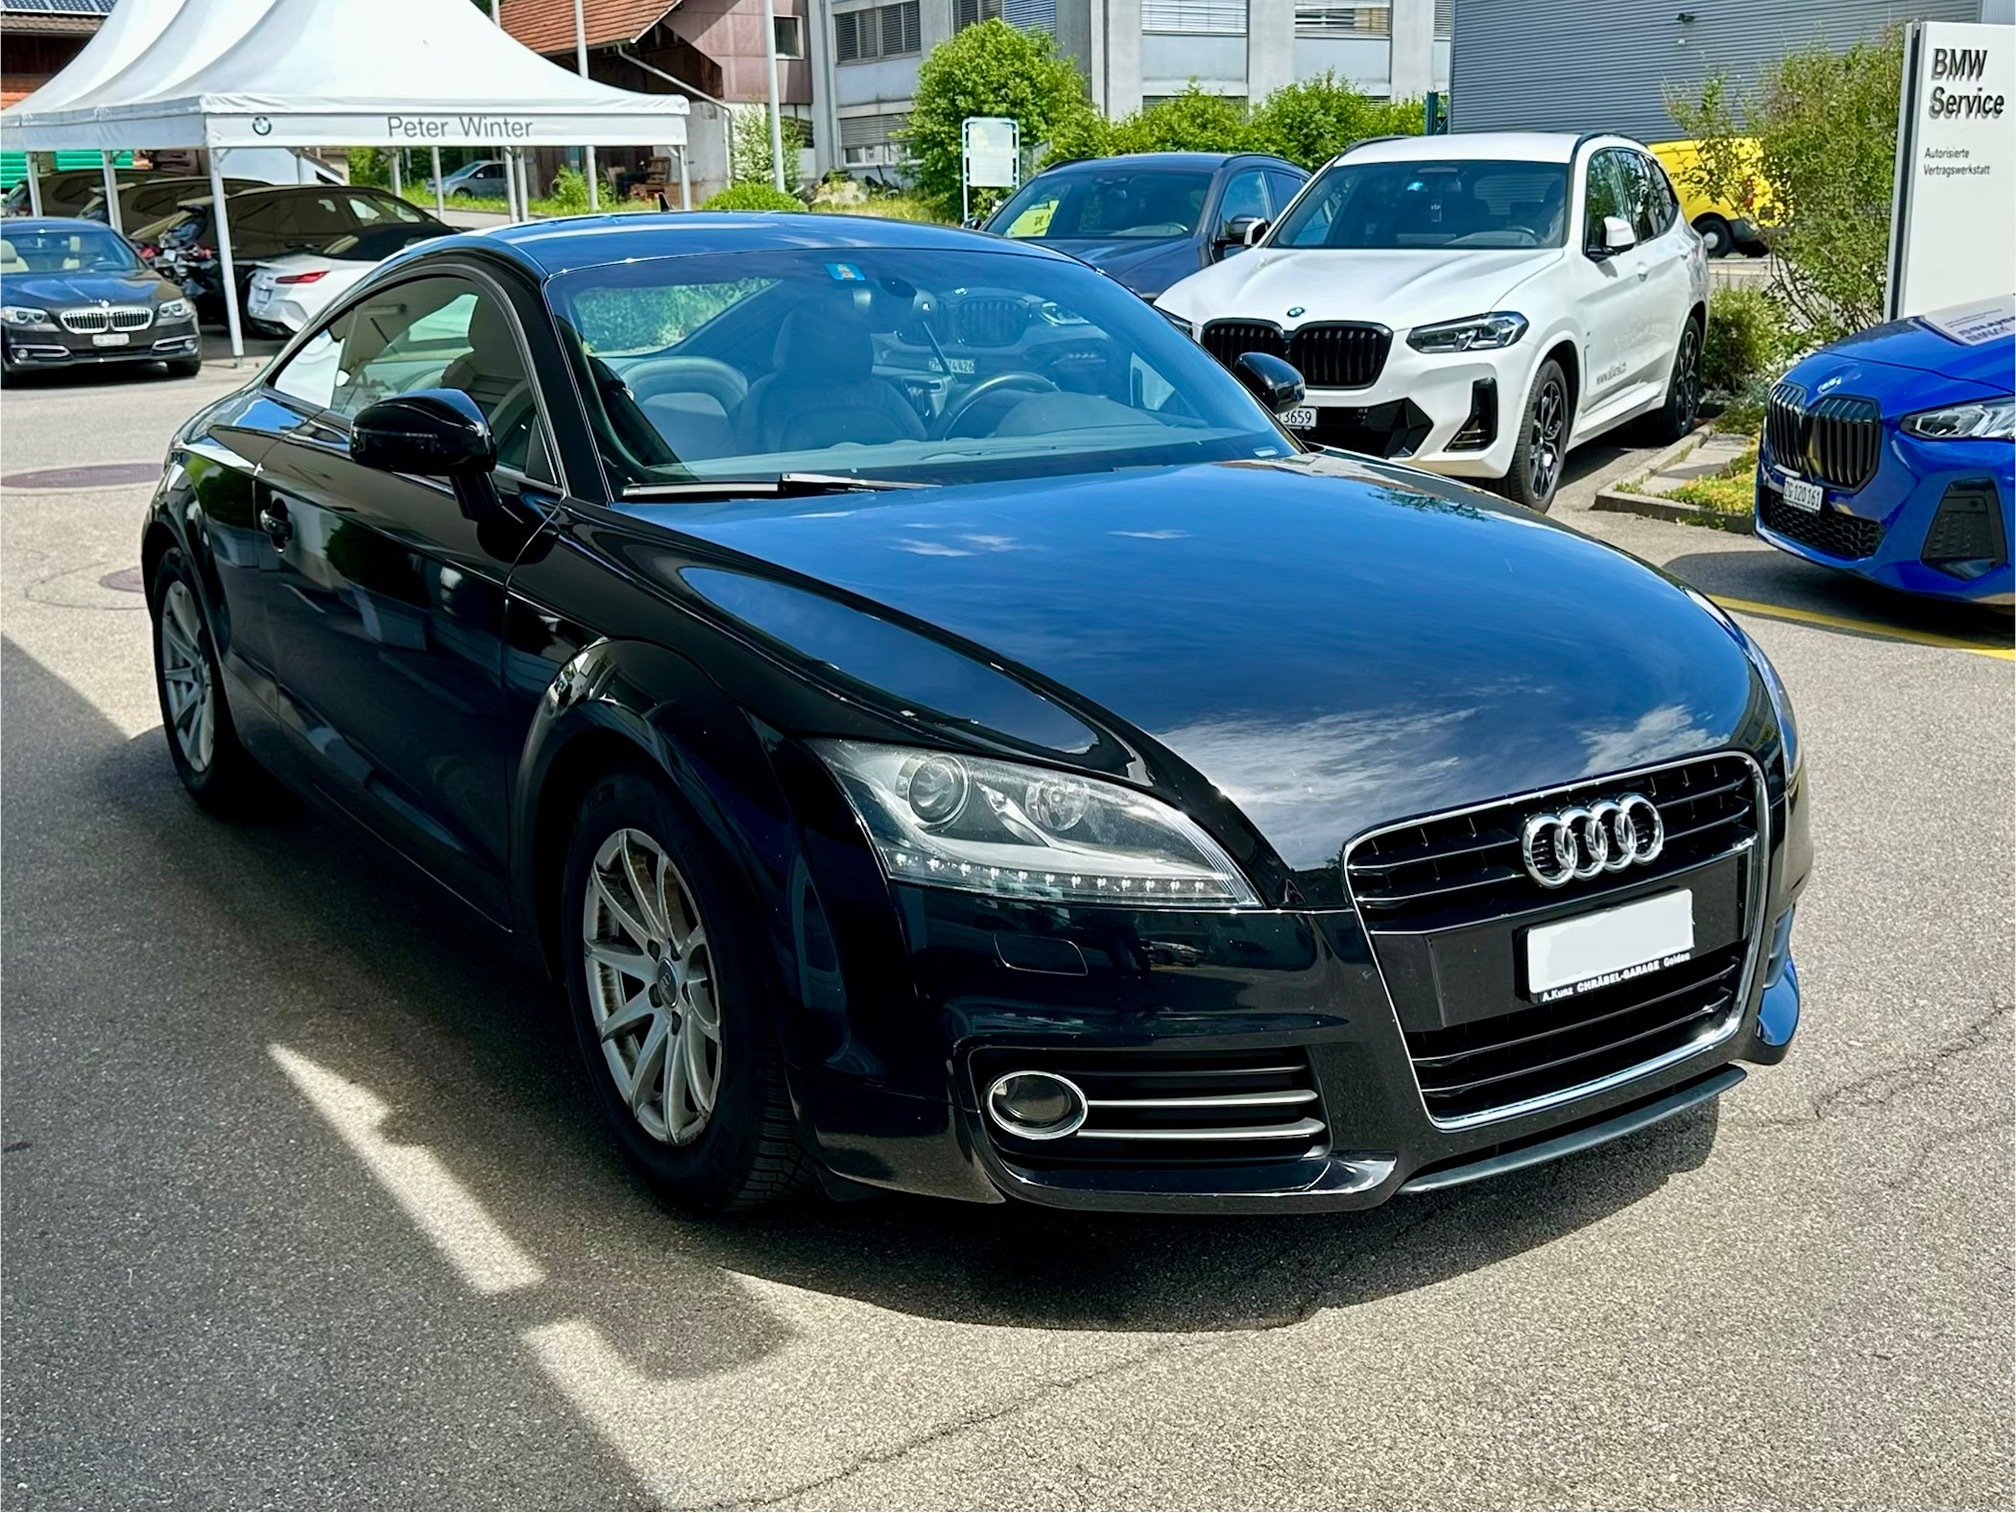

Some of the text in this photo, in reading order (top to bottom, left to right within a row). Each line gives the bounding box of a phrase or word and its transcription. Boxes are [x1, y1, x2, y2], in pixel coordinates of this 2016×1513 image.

[1931, 48, 1988, 81] BMW
[1928, 86, 2005, 119] Service
[387, 116, 533, 138] Peter Winter
[1924, 147, 1970, 159] Autorisierte
[1923, 164, 1991, 177] Vertragswerkstatt
